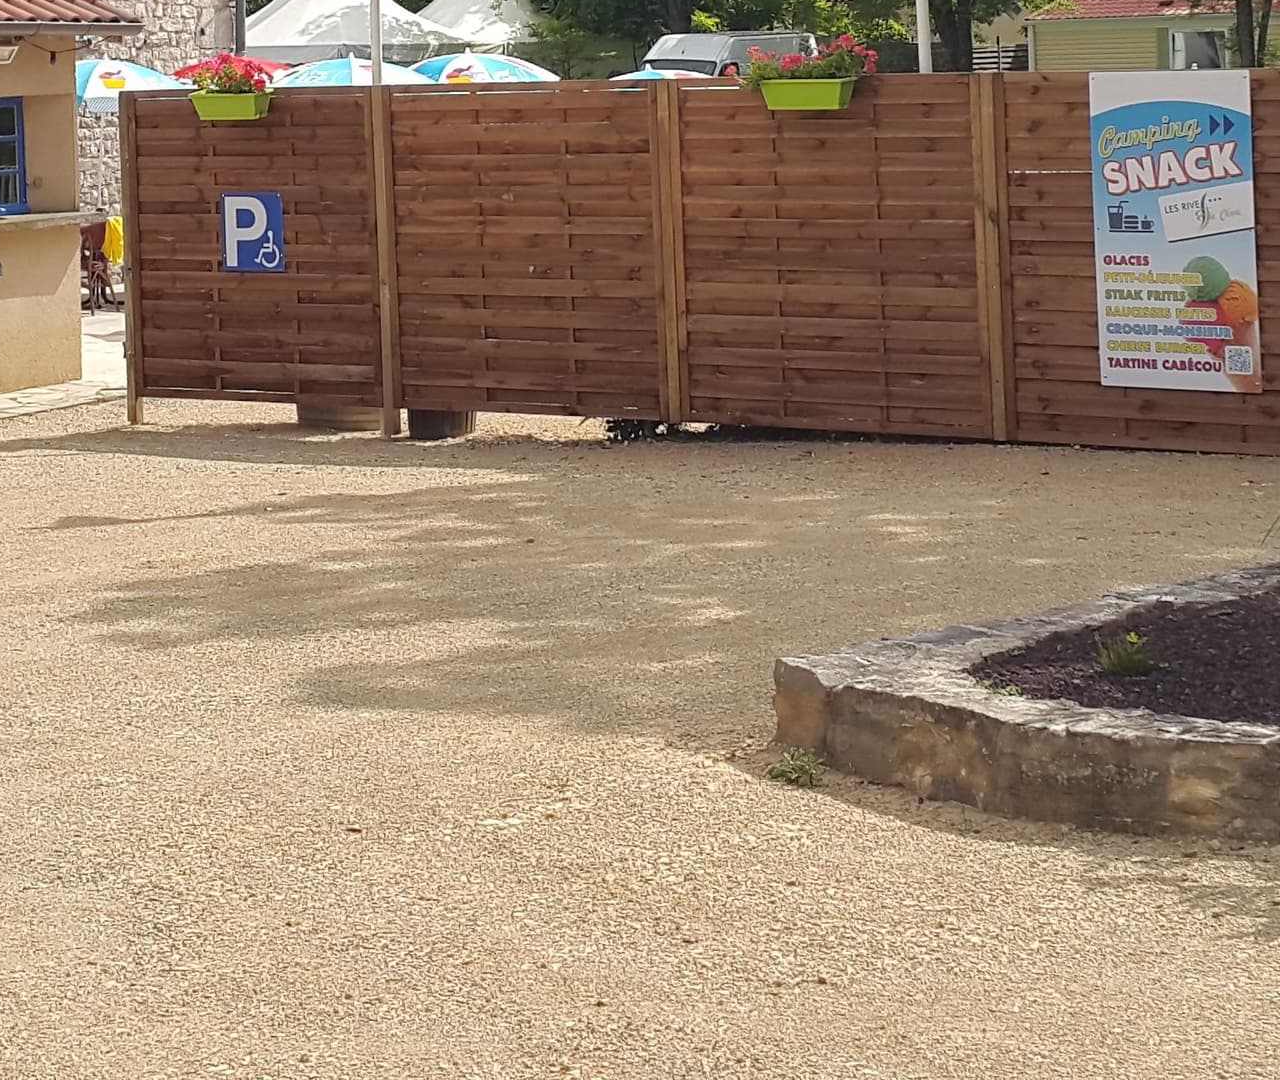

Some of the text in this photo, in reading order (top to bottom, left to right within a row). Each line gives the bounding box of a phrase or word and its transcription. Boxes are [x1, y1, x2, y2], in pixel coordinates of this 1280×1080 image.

[1098, 115, 1201, 158] Camping
[1103, 141, 1243, 195] SNACK
[1164, 203, 1179, 215] LES
[224, 196, 267, 267] P
[1103, 255, 1150, 267] GLACES
[1105, 289, 1187, 302] STEAK FRITES
[1106, 323, 1233, 338] CROQUE-MONSIEUR
[1107, 357, 1223, 373] TARTINE CABÉCOU
